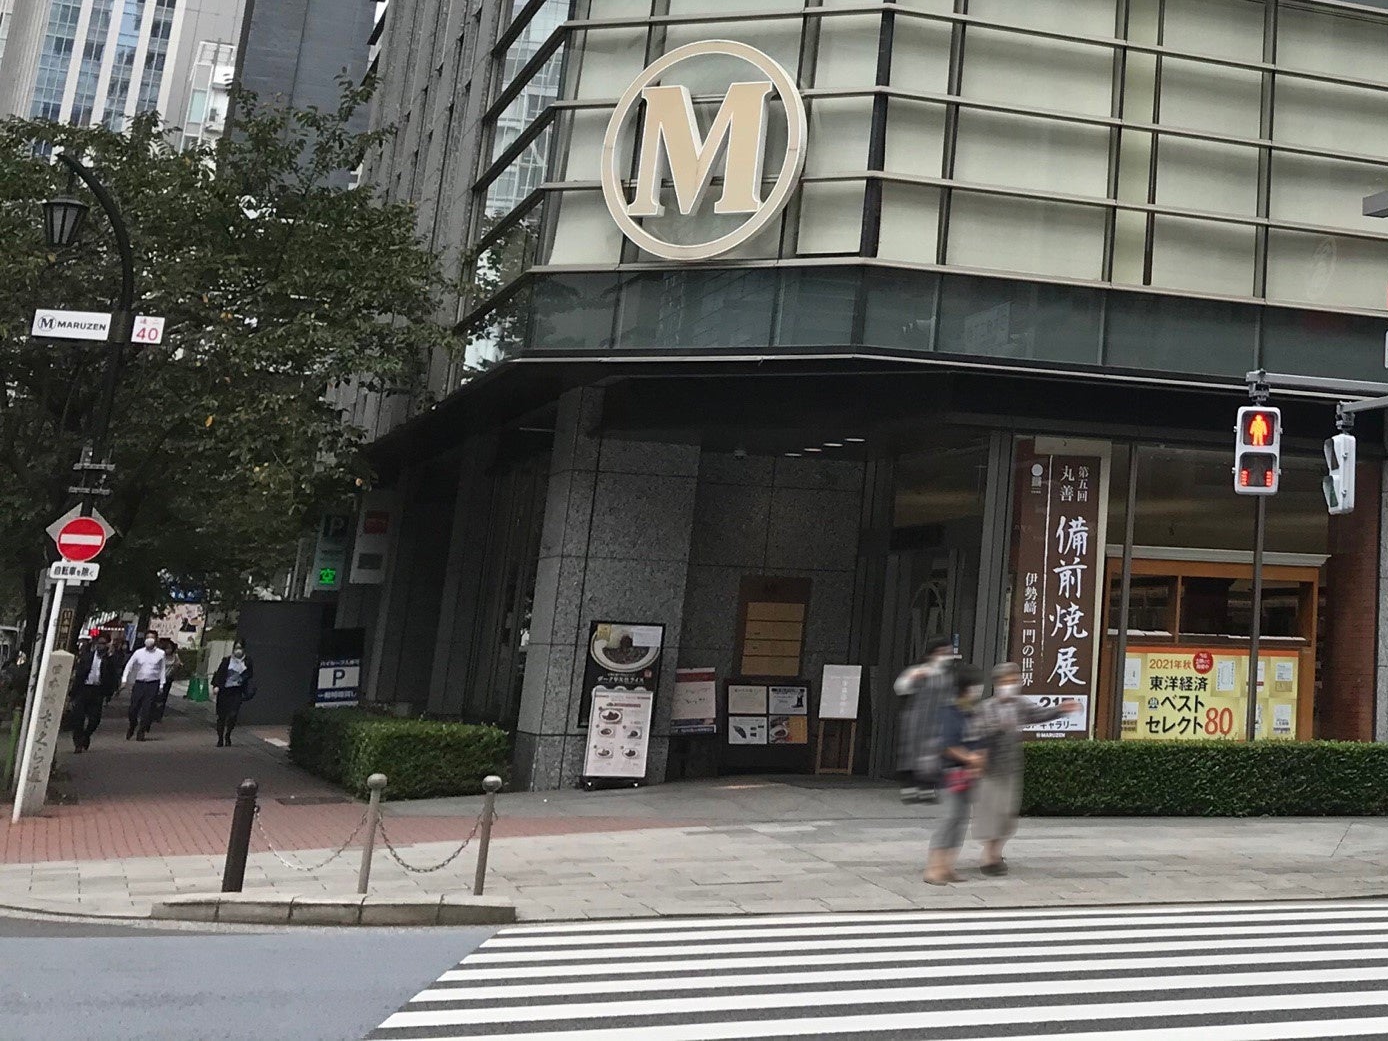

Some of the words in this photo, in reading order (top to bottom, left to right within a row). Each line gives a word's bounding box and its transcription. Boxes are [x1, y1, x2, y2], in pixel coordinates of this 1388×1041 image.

[57, 320, 107, 331] MARUZEN
[136, 327, 159, 341] 40
[1060, 465, 1075, 502] 丸善
[1077, 466, 1089, 502] 第五回
[1047, 515, 1089, 687] 備前焼展
[1150, 659, 1192, 670] 2021年秋
[332, 669, 345, 686] P
[1150, 675, 1208, 692] 東洋経済
[1161, 695, 1205, 713] ベスト
